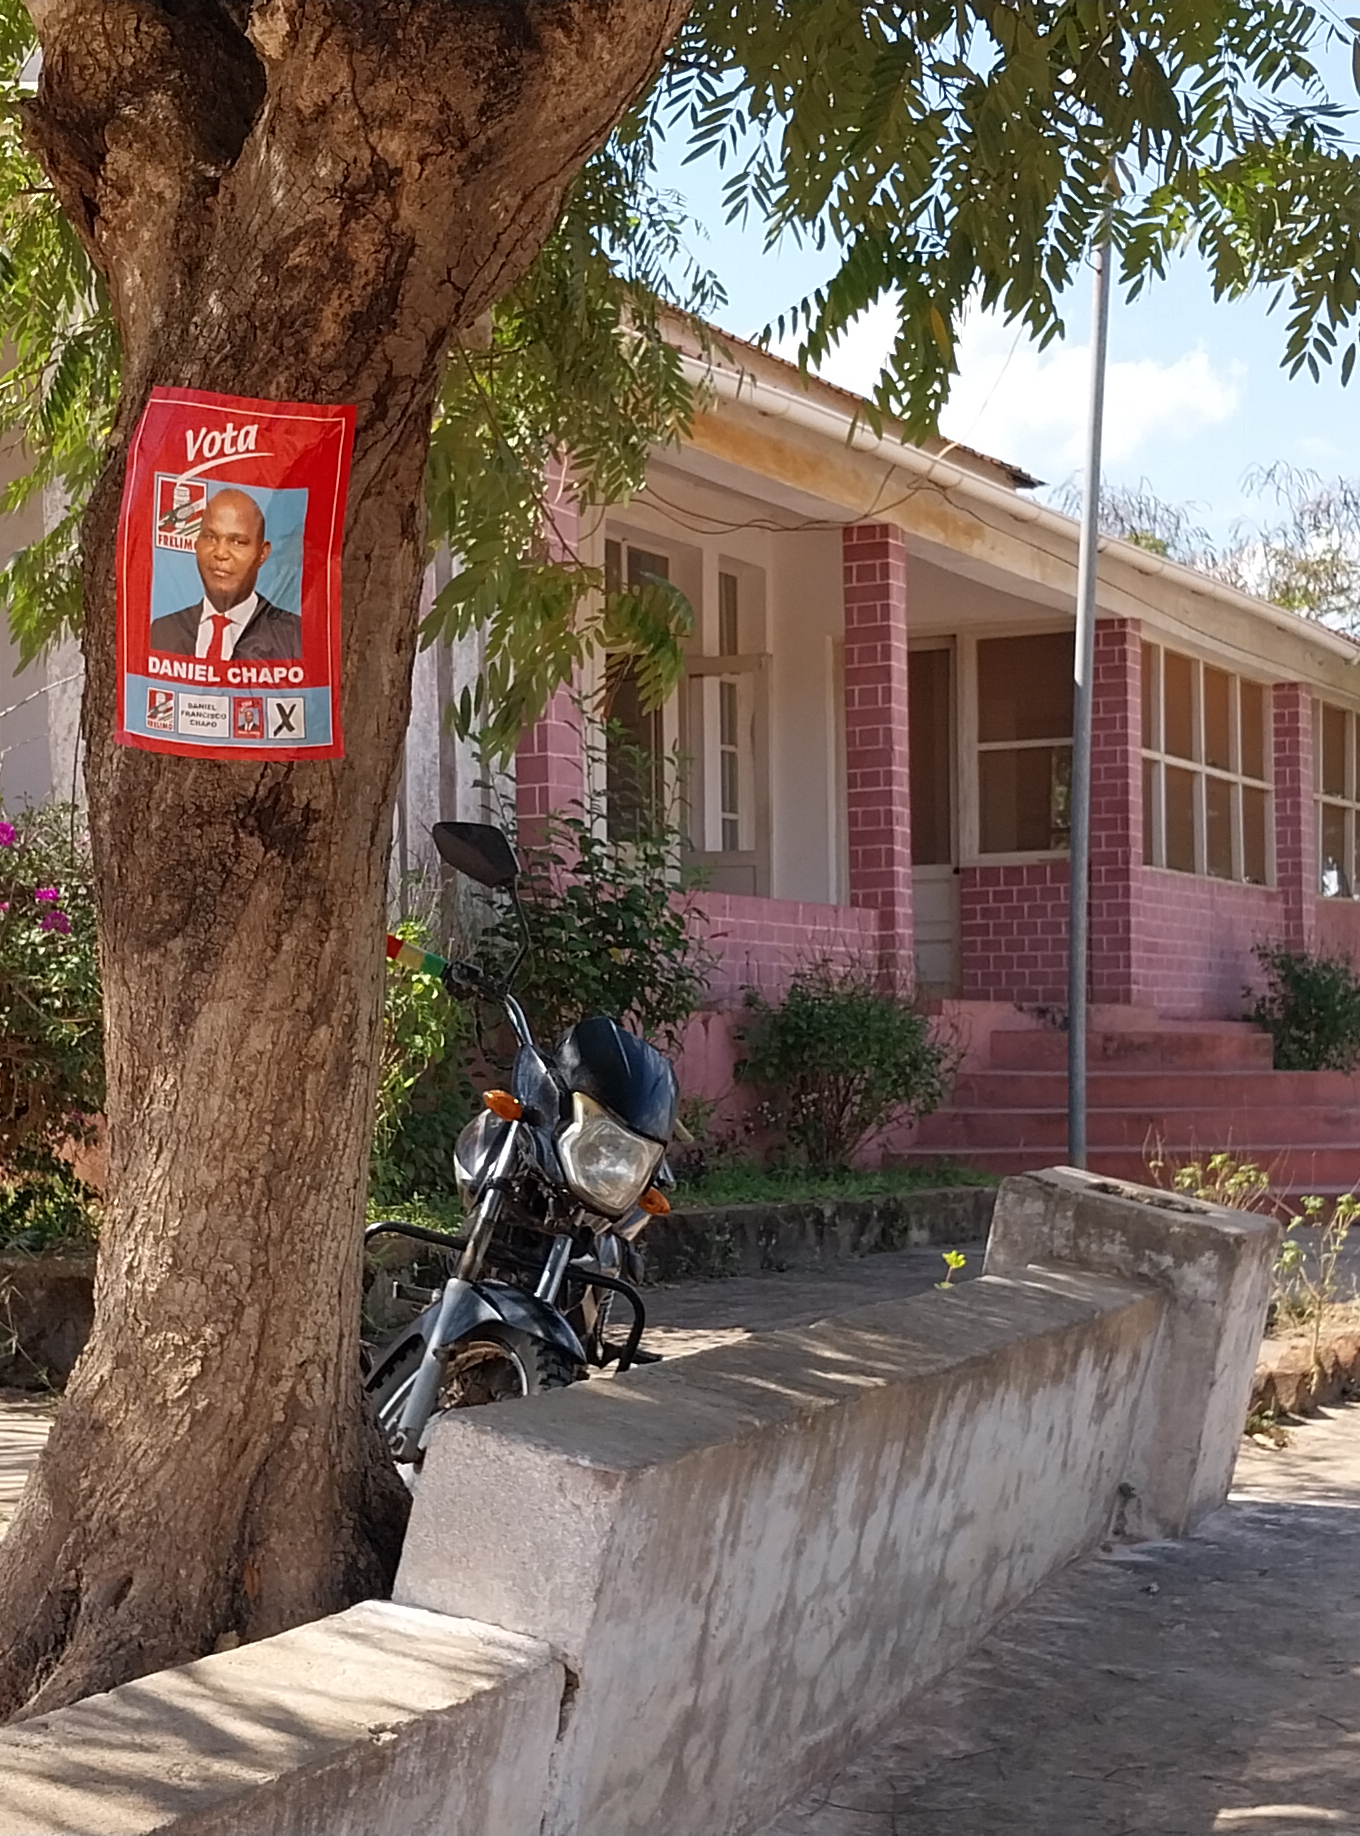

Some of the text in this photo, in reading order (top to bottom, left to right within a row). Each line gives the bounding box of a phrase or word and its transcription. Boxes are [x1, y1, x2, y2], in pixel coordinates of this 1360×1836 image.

[185, 422, 259, 462] Vota
[148, 656, 304, 684] DANIEL CHAPO
[187, 702, 217, 711] DANIEL
[181, 710, 227, 720] FRANCISCO
[189, 719, 217, 728] CHAPO
